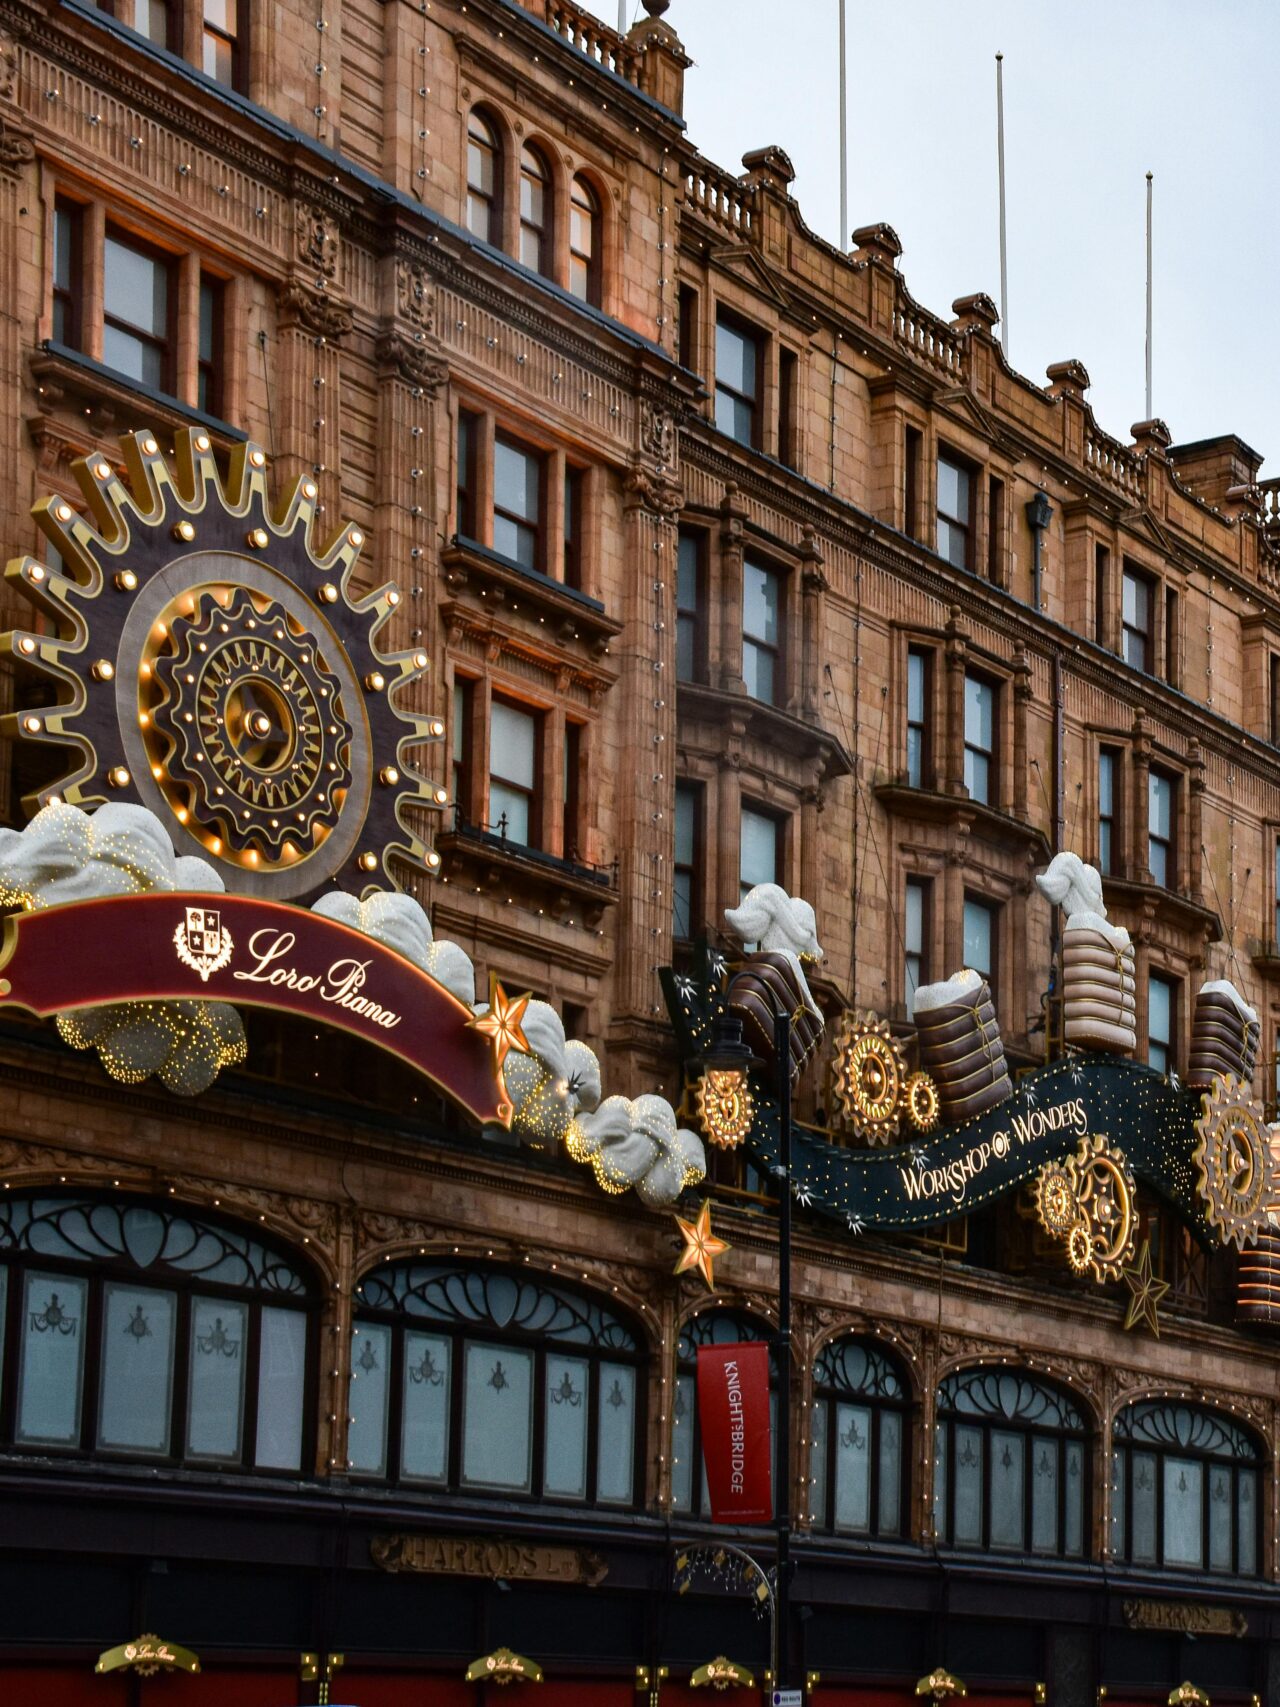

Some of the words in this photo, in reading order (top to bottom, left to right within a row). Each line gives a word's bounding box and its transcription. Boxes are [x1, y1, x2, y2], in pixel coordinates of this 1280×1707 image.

[233, 928, 321, 993] Loro
[319, 958, 402, 1029] Piana
[900, 1142, 991, 1203] WORKSHOP
[992, 1130, 1011, 1159] OF
[1011, 1097, 1088, 1146] WONDERS
[403, 1536, 538, 1577] HARRODS
